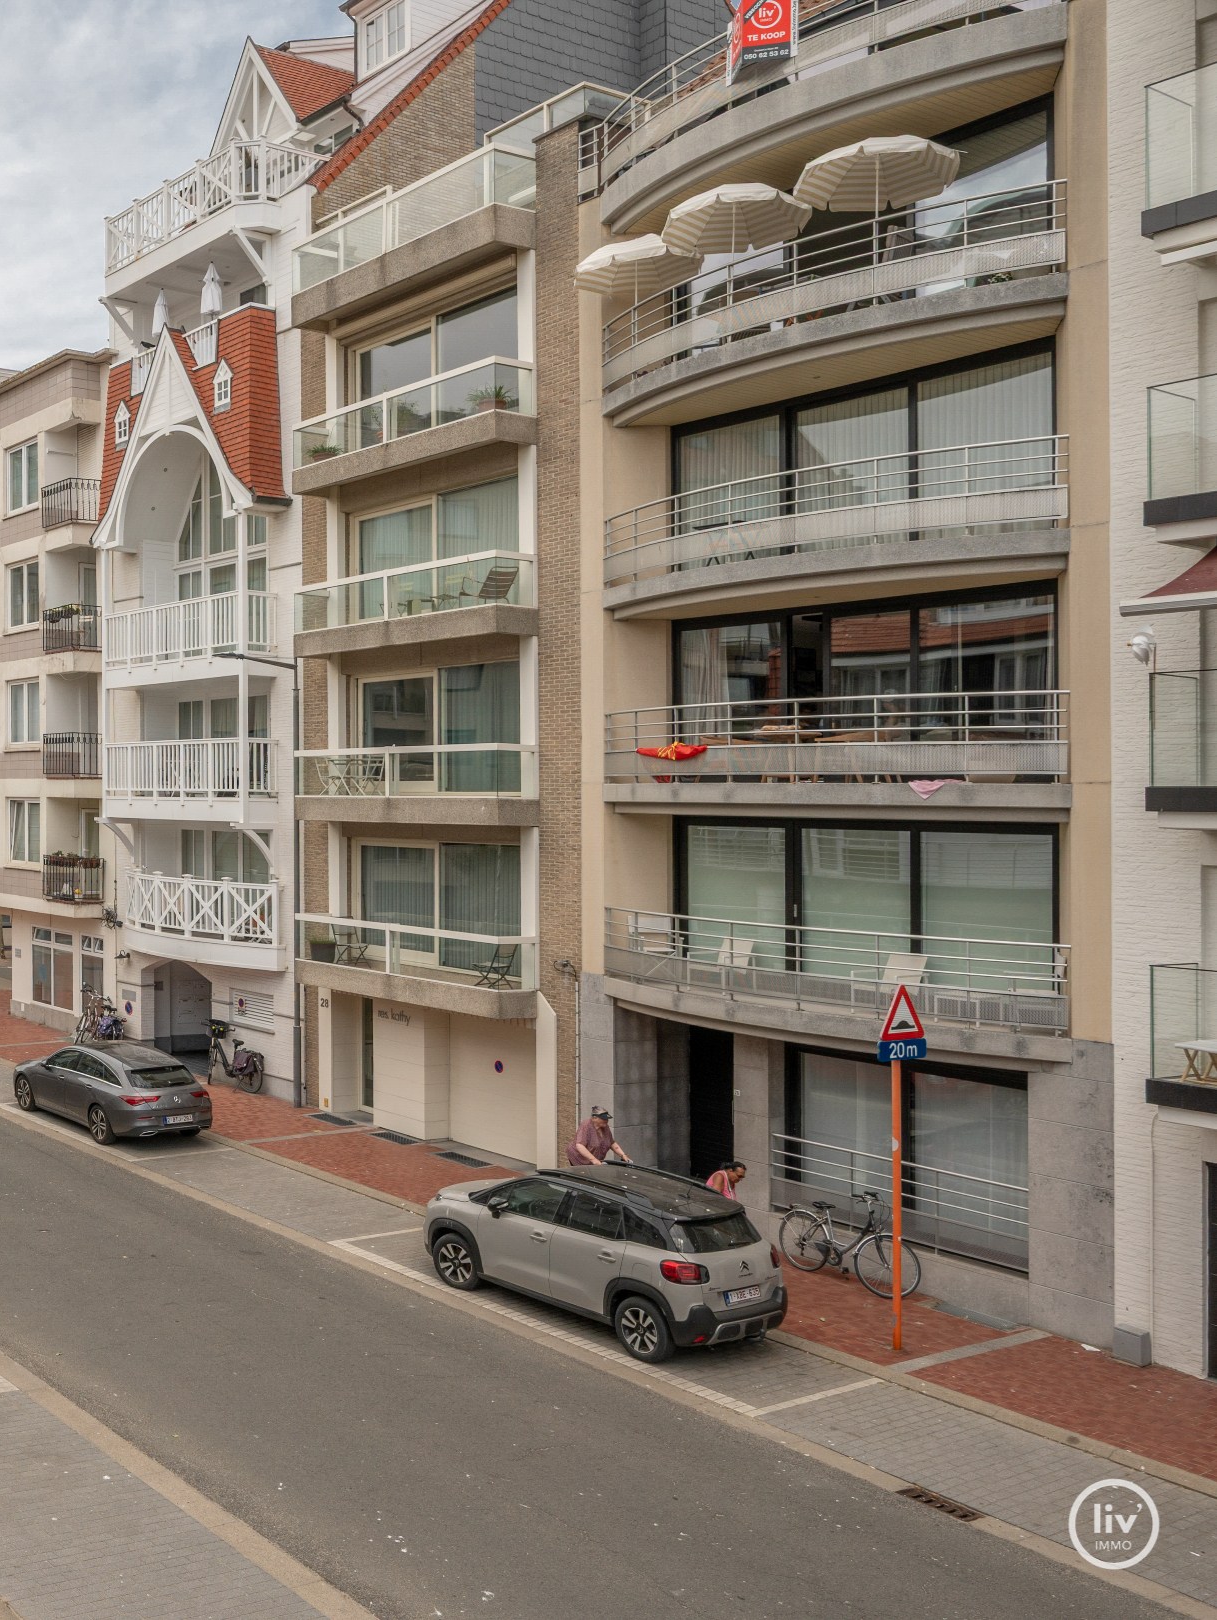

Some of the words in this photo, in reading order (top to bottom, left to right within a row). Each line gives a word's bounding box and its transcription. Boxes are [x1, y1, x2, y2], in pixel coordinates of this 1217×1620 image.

[747, 34, 759, 42] TE
[760, 31, 786, 40] KOOP
[320, 998, 329, 1008] 28
[390, 1008, 411, 1027] kathy
[888, 1042, 905, 1059] 20
[906, 1044, 918, 1058] m
